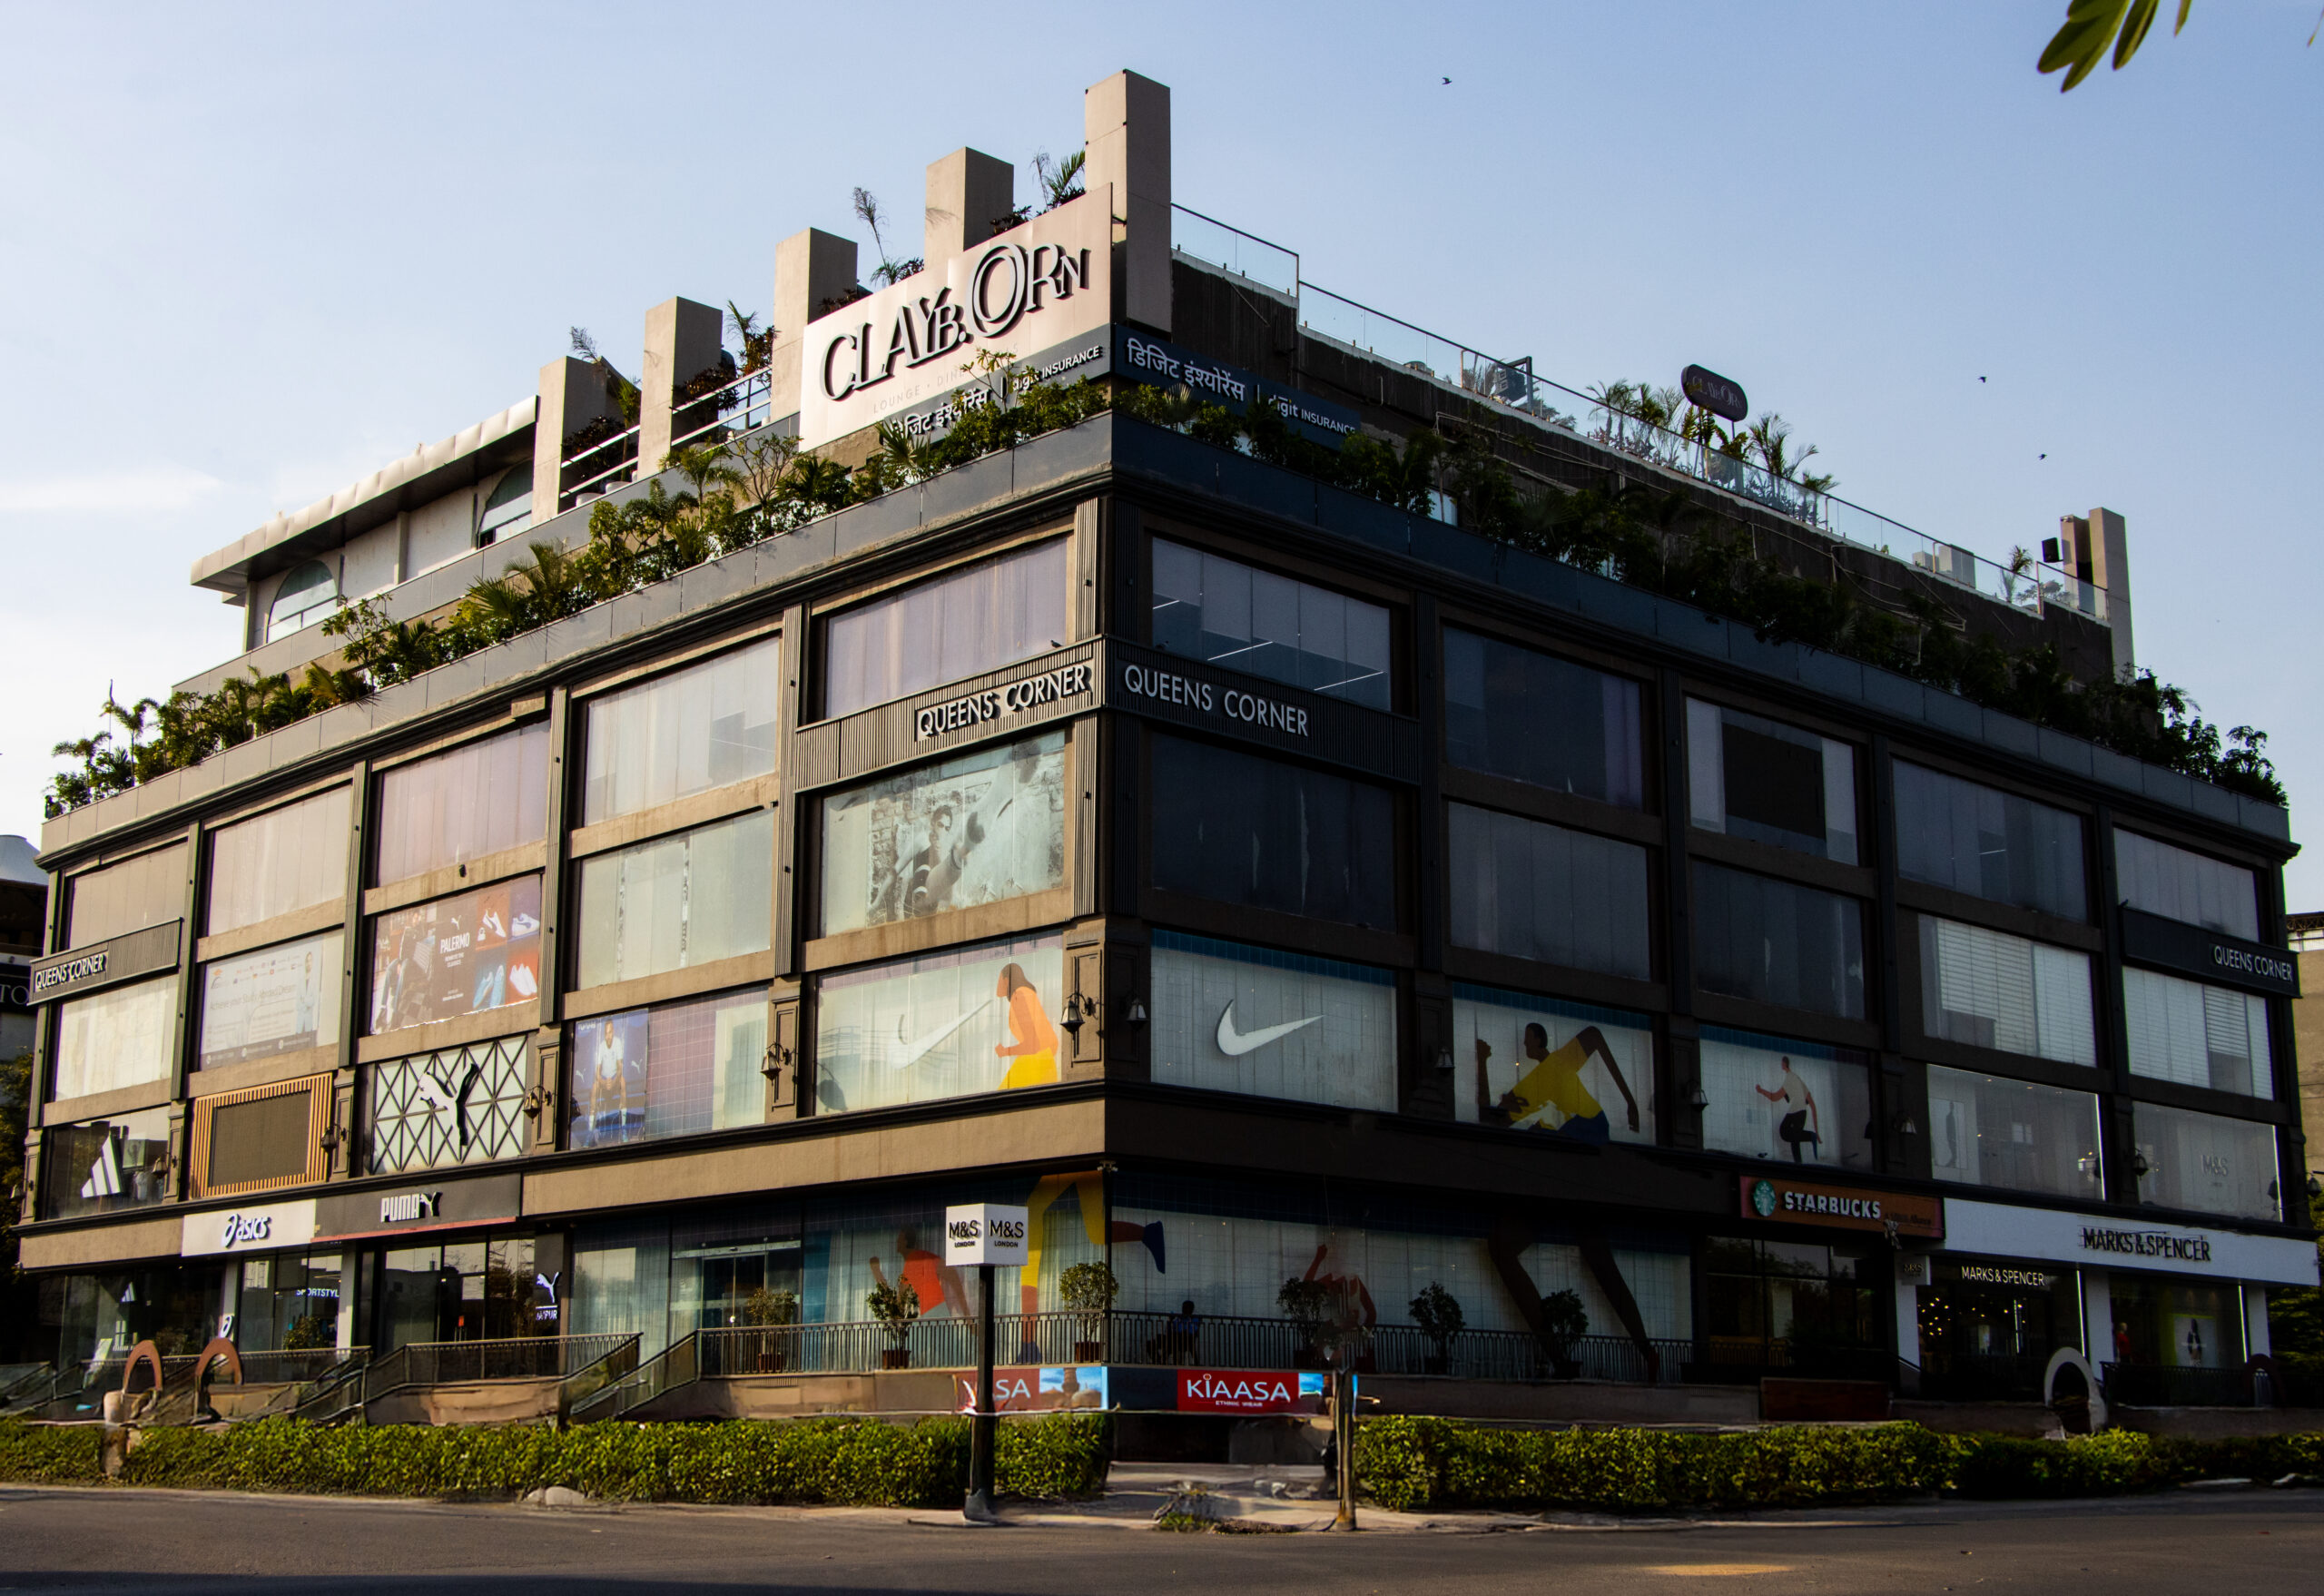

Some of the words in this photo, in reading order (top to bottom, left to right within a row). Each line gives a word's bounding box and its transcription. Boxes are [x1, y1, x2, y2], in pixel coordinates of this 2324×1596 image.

[1041, 345, 1102, 379] INSURANCE
[1127, 338, 1180, 379] डिजिट
[1183, 360, 1245, 401] इंश्योरेंस
[872, 383, 921, 414] LOUNGE
[917, 692, 997, 736] QUEENS
[1005, 664, 1091, 711] CORNER
[1125, 664, 1213, 712] QUEENS
[1223, 689, 1309, 737] CORNER
[440, 932, 470, 954] PALERMO
[36, 964, 69, 989] QUEENS
[70, 953, 106, 980] CORNER
[2214, 945, 2252, 972] QUEENS
[2253, 955, 2293, 981] CORNER
[380, 1193, 421, 1223] PUMA
[1783, 1190, 1882, 1220] STARBUCKS
[949, 1220, 980, 1238] M&S
[990, 1219, 1024, 1238] M&S
[295, 1286, 340, 1298] SPORTSTYL
